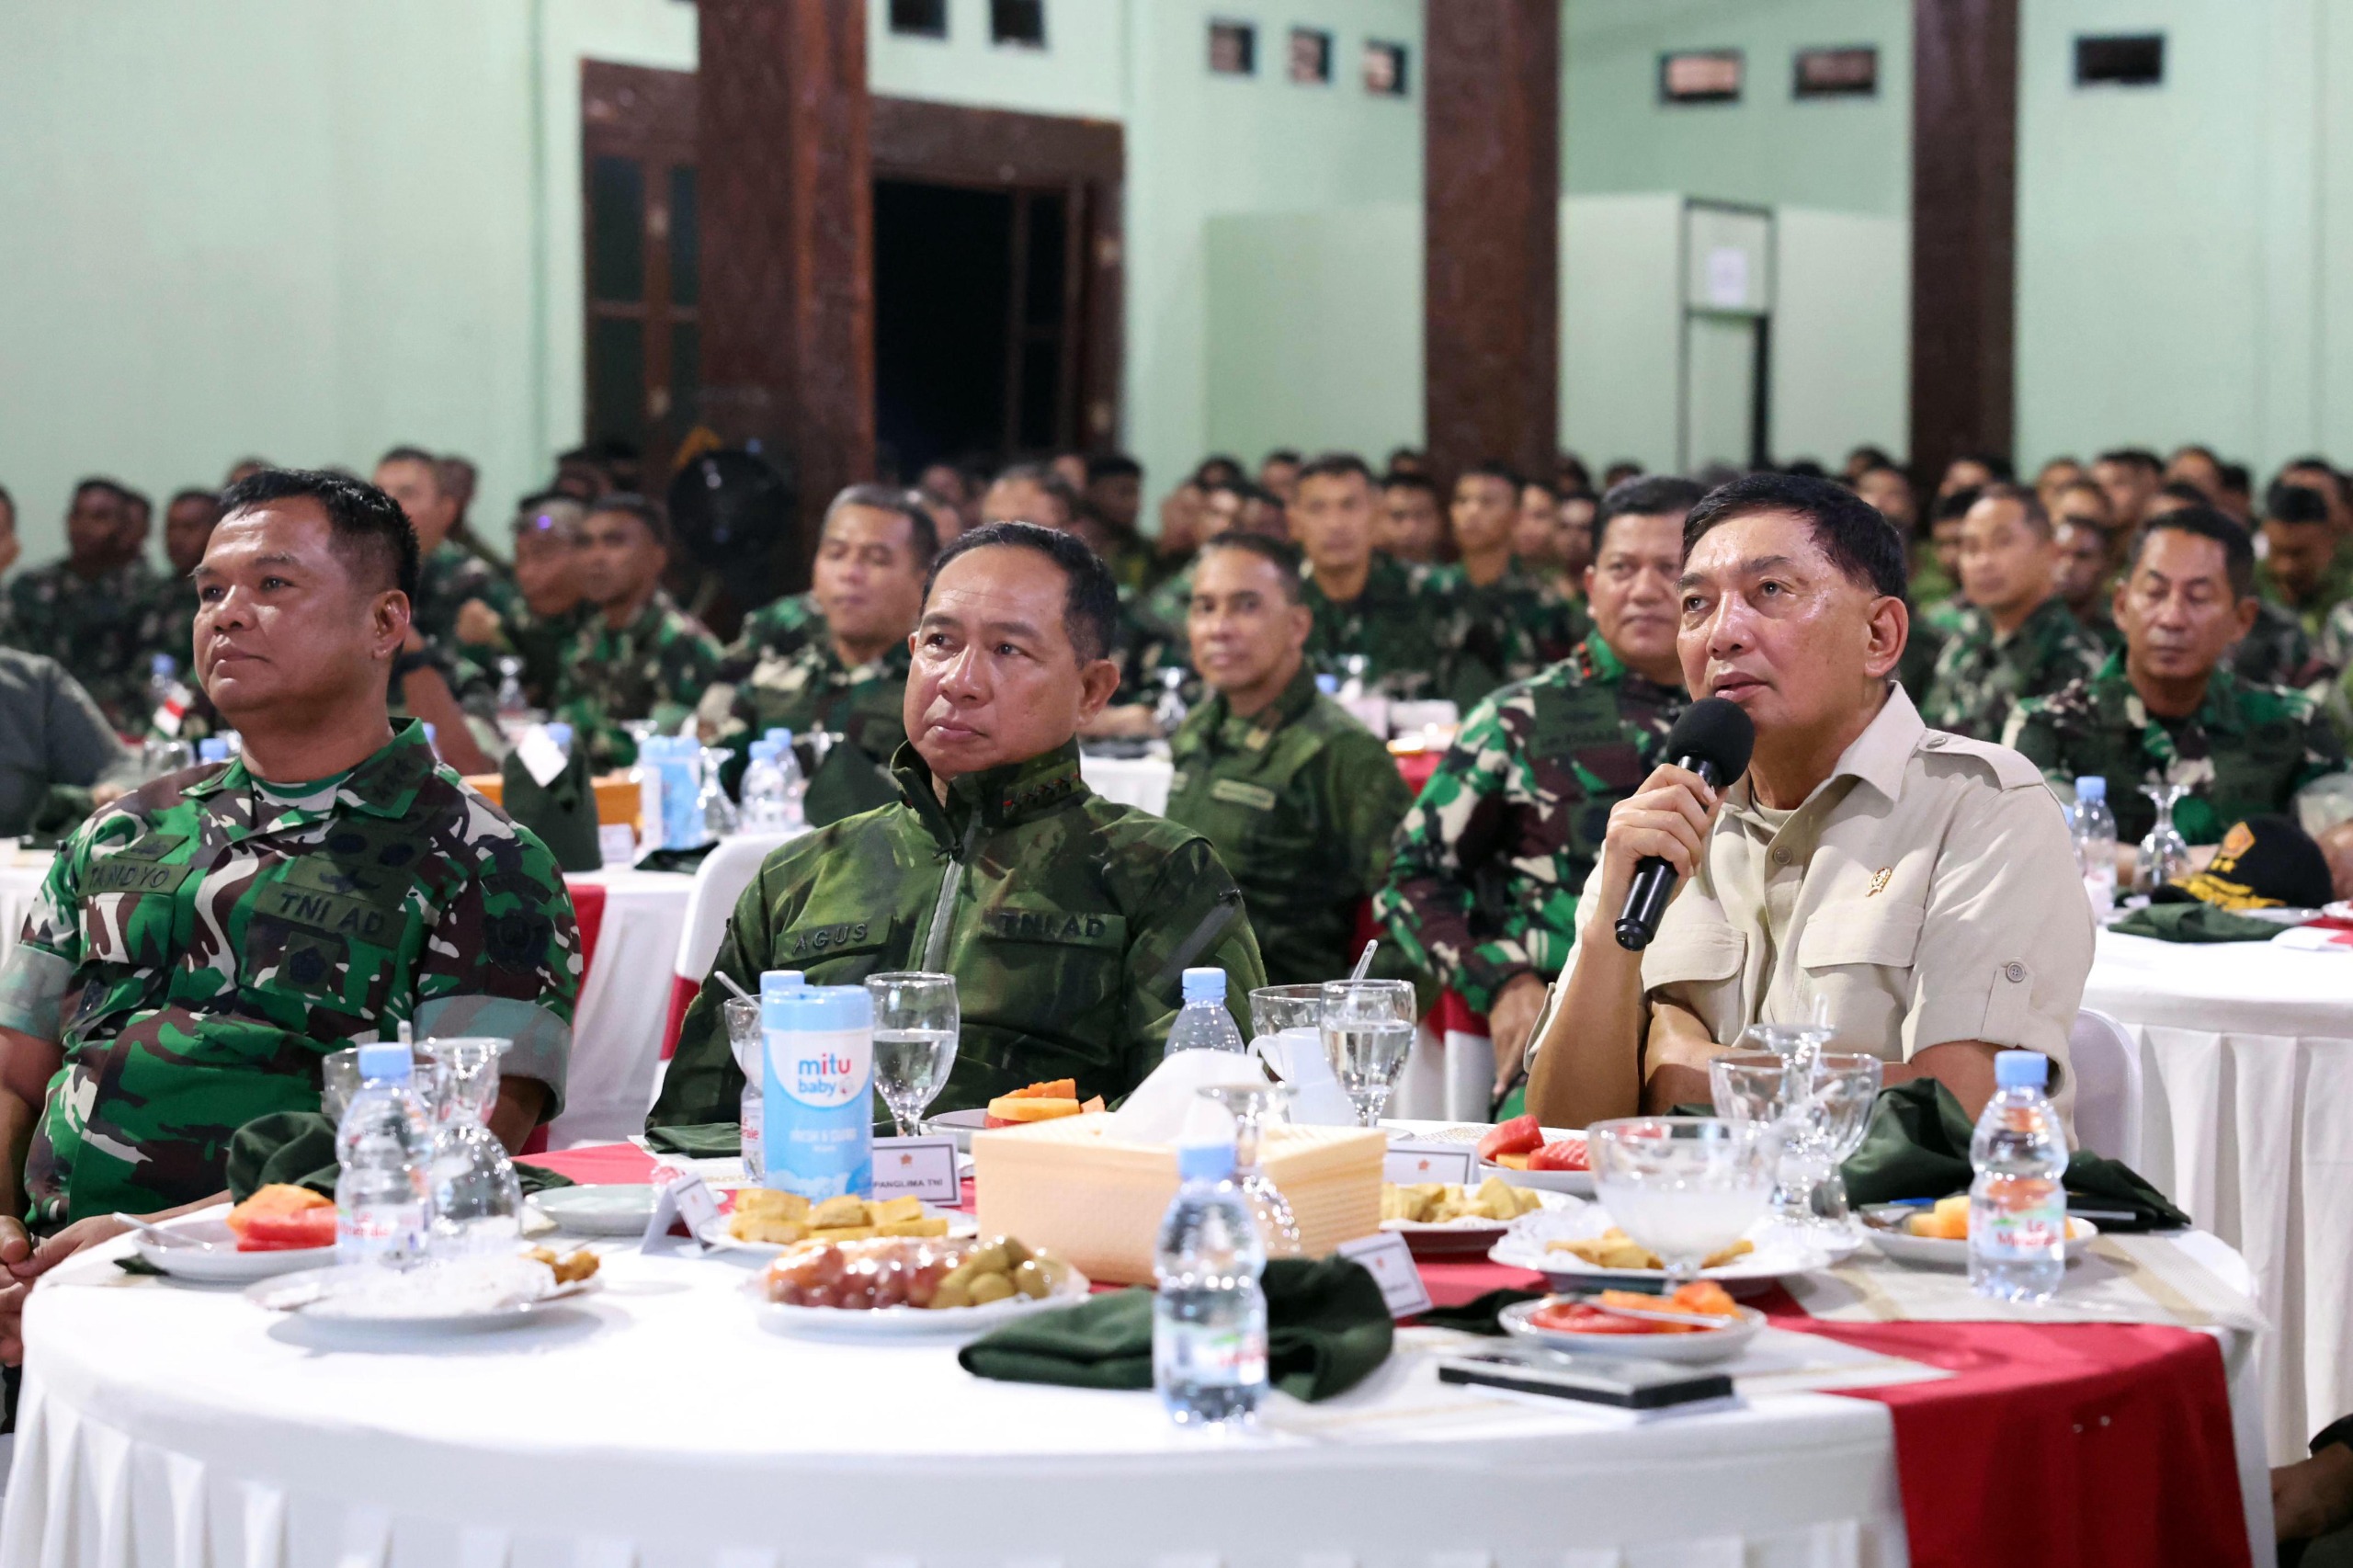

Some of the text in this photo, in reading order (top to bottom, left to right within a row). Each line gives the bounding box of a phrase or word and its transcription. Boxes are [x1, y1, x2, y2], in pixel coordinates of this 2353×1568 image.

[279, 891, 384, 934] TNI AD
[1062, 914, 1106, 937] AD
[792, 923, 868, 955] AGUS
[798, 1052, 851, 1074] mitu
[798, 1078, 836, 1097] baby
[874, 1179, 925, 1188] PANGLIMA
